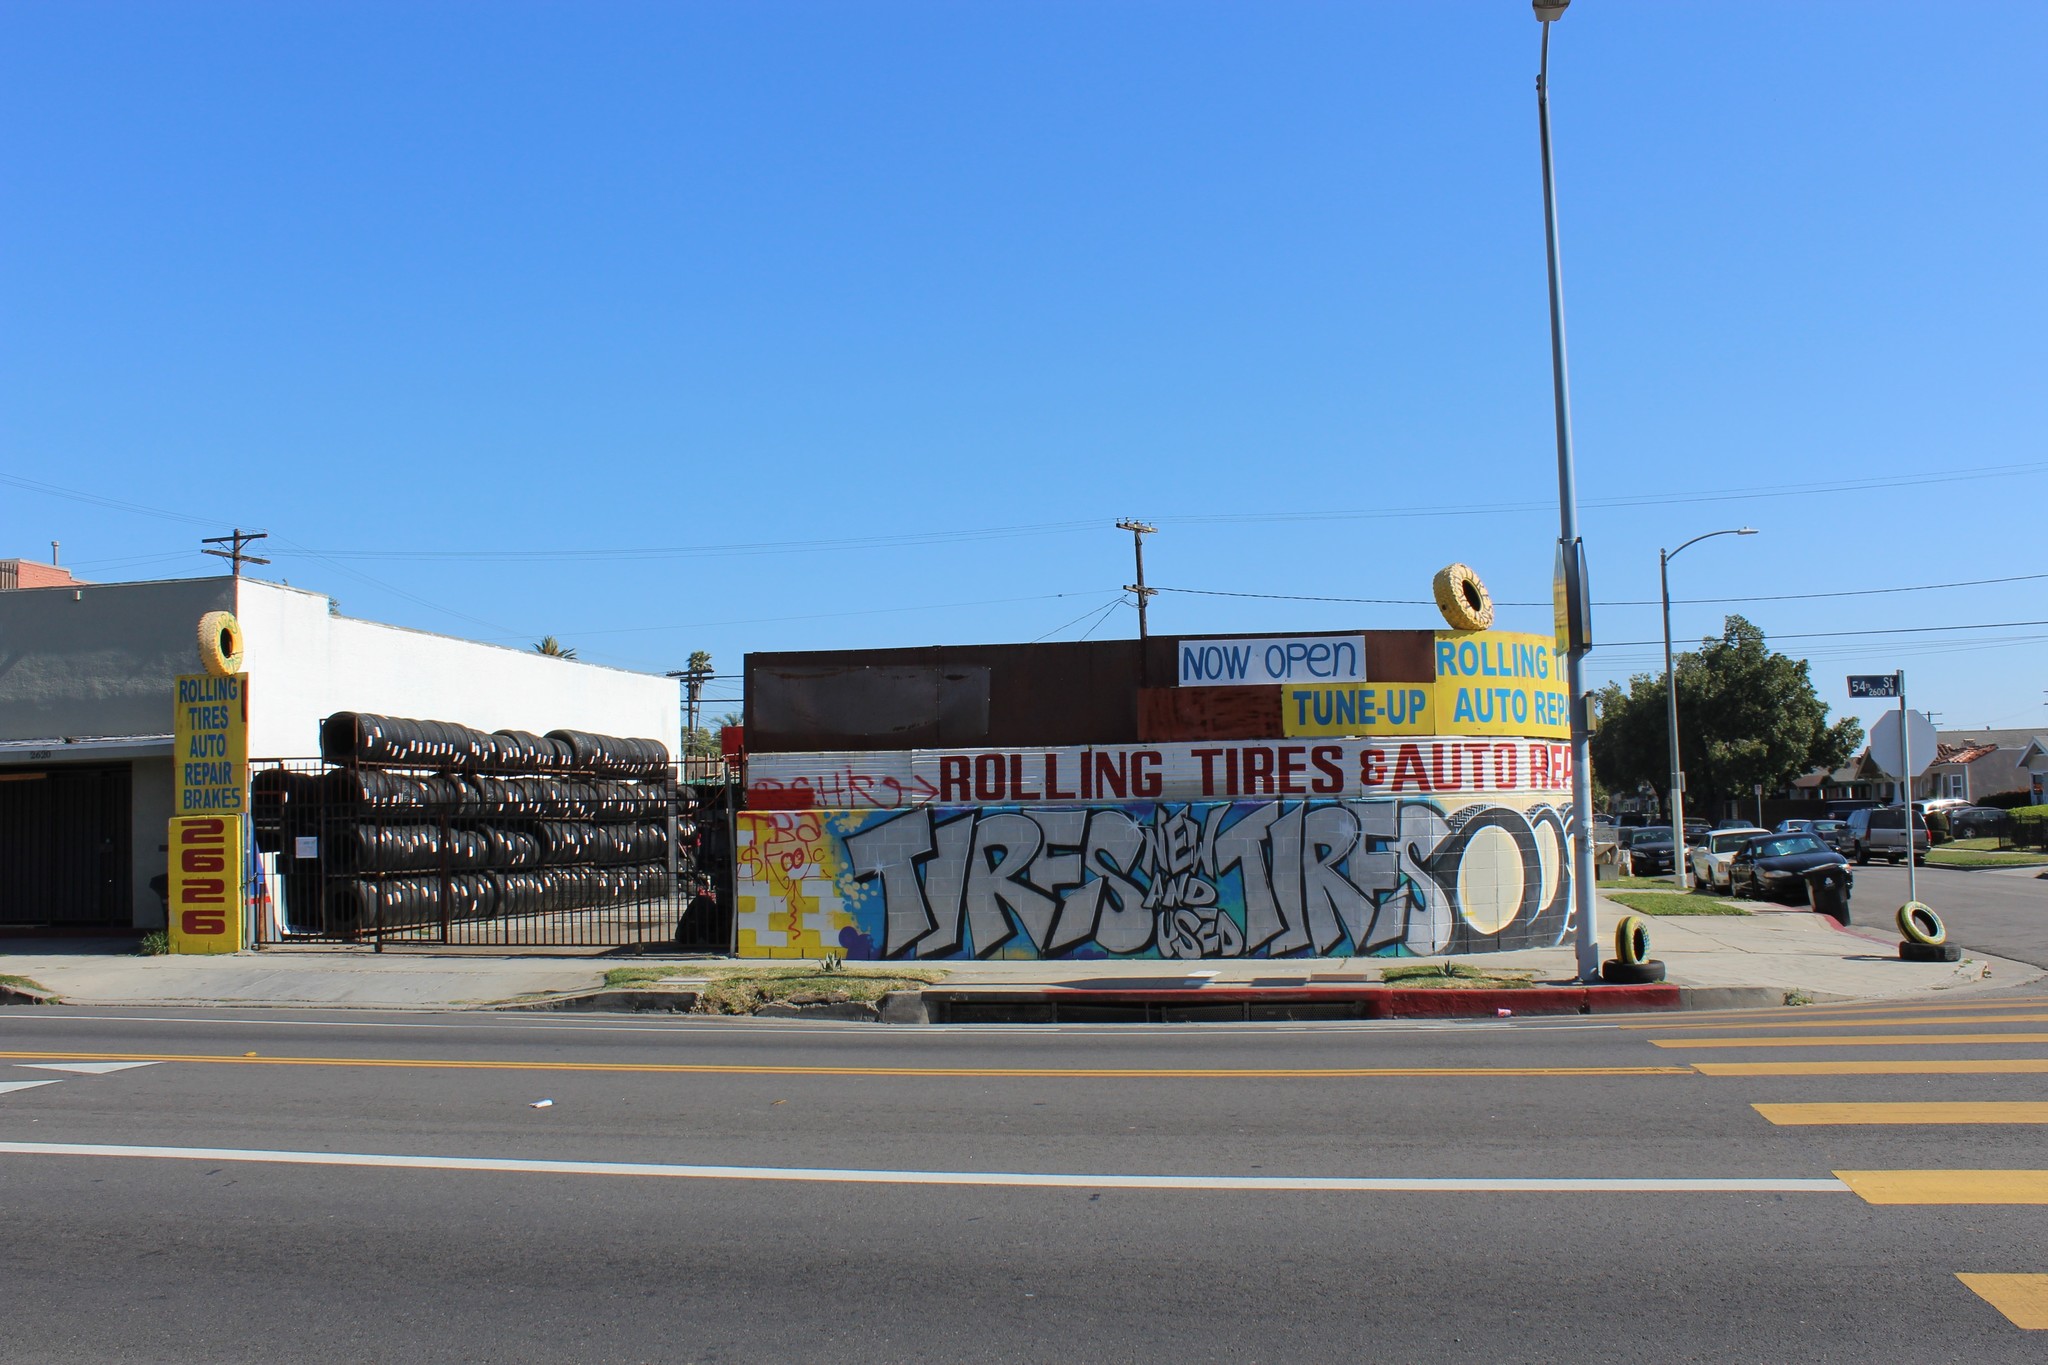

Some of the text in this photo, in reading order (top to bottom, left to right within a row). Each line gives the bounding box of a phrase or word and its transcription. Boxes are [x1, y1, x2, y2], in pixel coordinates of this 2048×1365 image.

[1182, 646, 1251, 680] NOW
[1437, 641, 1569, 683] ROLLING TI
[179, 677, 238, 704] ROLLING
[1869, 688, 1886, 696] 2600
[1883, 677, 1894, 688] St
[188, 707, 229, 731] TIRES
[1293, 690, 1426, 725] TUNE-UP
[1453, 688, 1528, 724] AUTO
[31, 750, 51, 760] 2620
[189, 734, 226, 758] AUTO
[185, 762, 232, 786] REPAIR
[940, 750, 1163, 801] ROLLING
[1191, 745, 1344, 796] TIRES
[184, 787, 240, 809] BRAKES
[1139, 803, 1234, 881] NEW
[181, 818, 226, 935] 2626
[843, 805, 1156, 962] TIRES
[1142, 871, 1217, 909] AND
[1213, 800, 1454, 958] TIRES
[1157, 907, 1244, 960] USED
